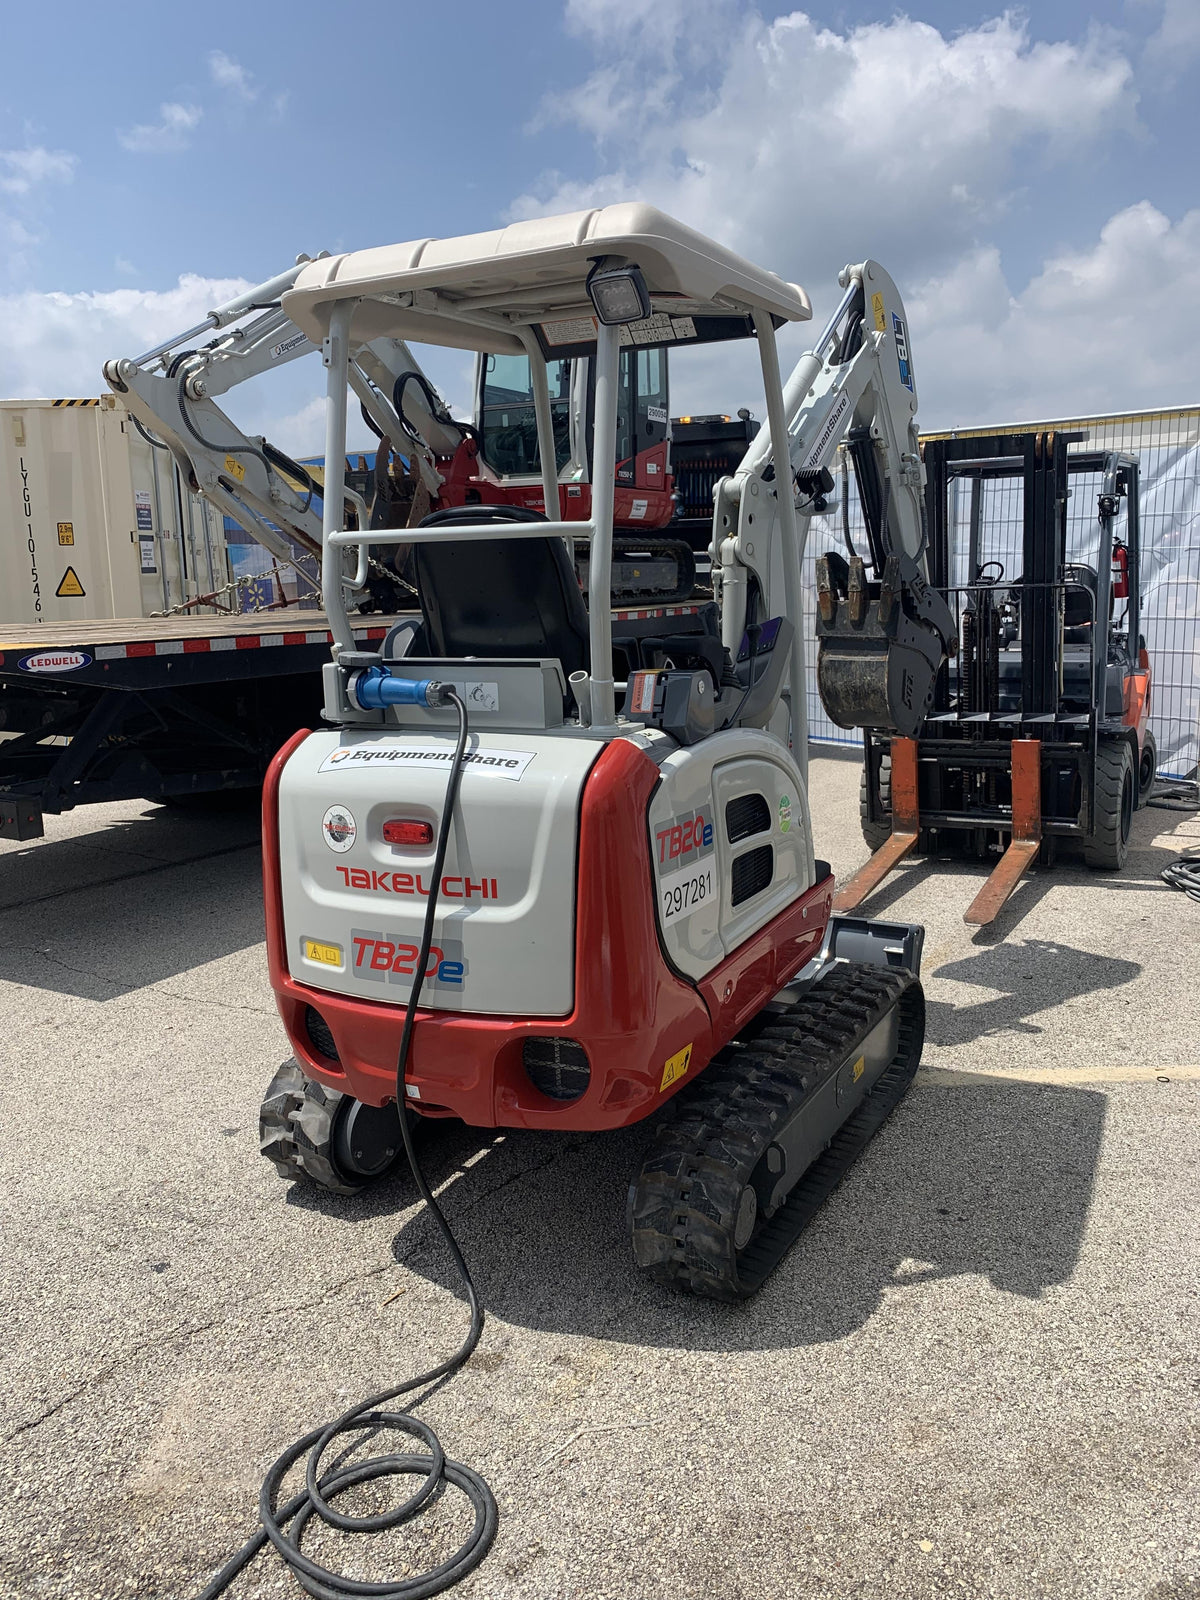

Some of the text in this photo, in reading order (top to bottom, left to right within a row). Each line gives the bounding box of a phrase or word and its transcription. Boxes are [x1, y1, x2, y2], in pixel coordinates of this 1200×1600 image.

[20, 457, 32, 517] LYGU
[27, 523, 41, 612] 101546
[31, 656, 81, 667] LEDWELL
[656, 815, 713, 864] TB20e
[336, 866, 498, 899] TAKEUCHI
[664, 870, 711, 918] 297281
[353, 937, 464, 984] TB20e
